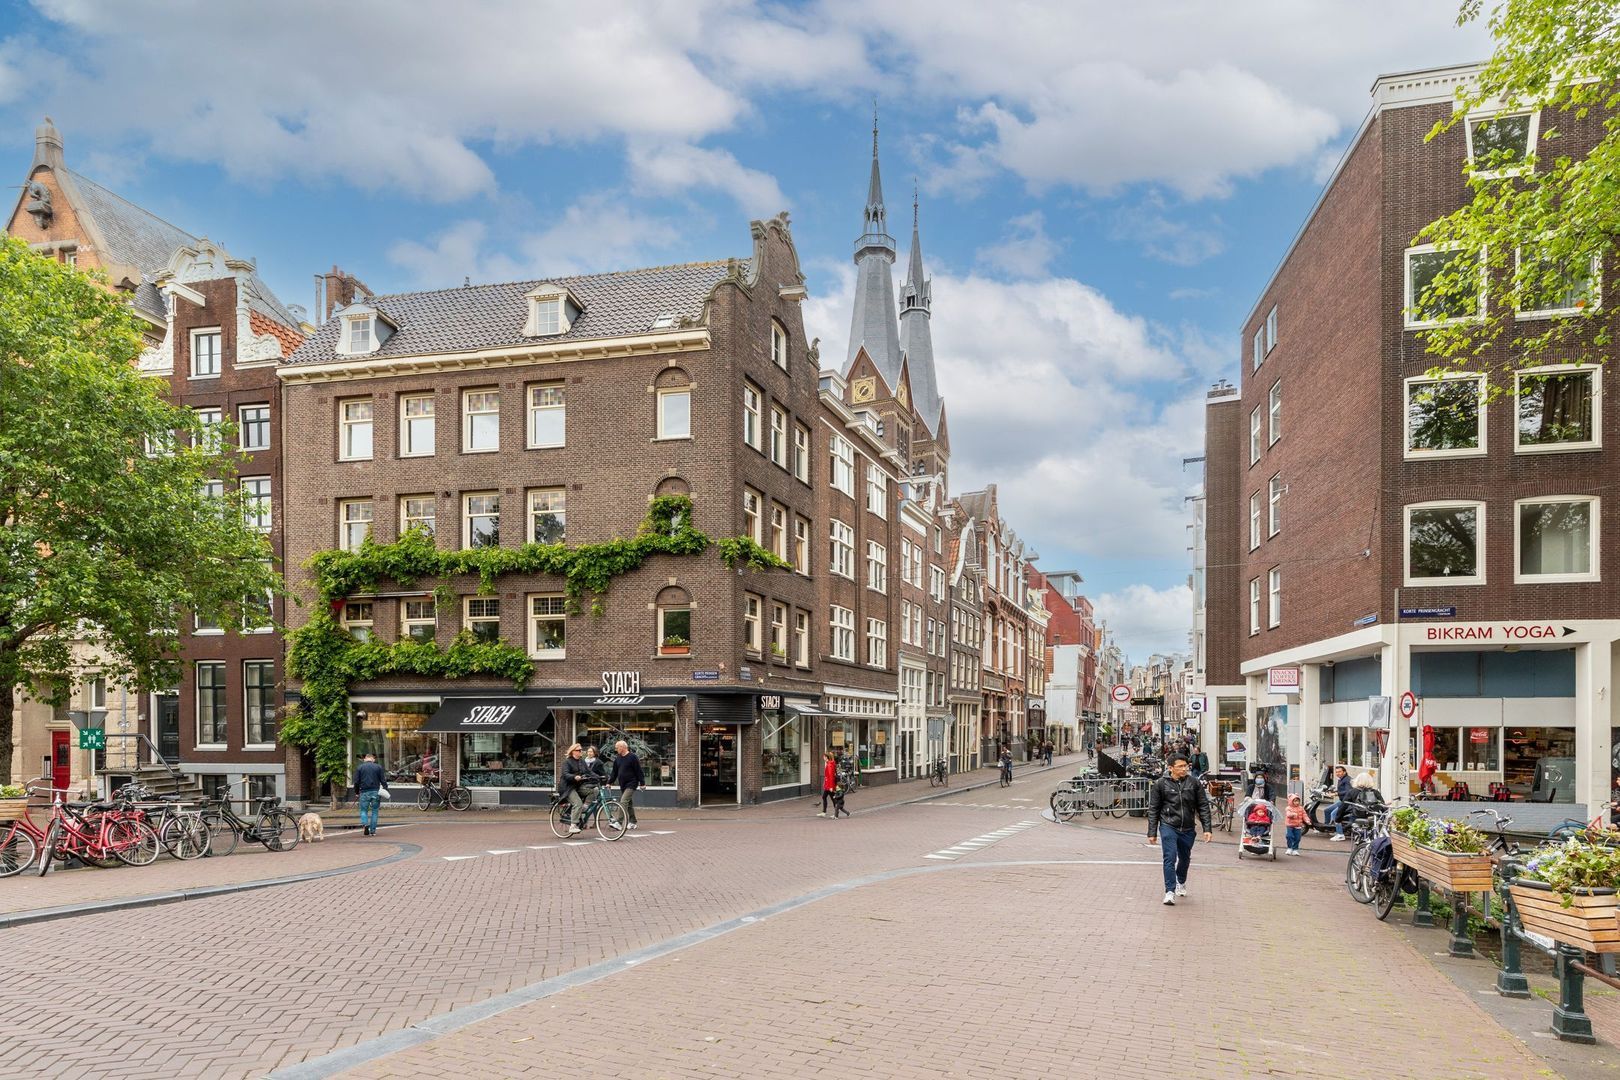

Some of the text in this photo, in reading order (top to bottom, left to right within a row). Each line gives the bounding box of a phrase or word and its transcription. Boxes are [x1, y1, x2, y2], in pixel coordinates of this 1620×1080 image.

[1427, 626, 1556, 640] BIKRAM YOGA
[602, 671, 640, 694] STACH
[761, 695, 780, 709] STACH
[463, 706, 516, 723] STACH
